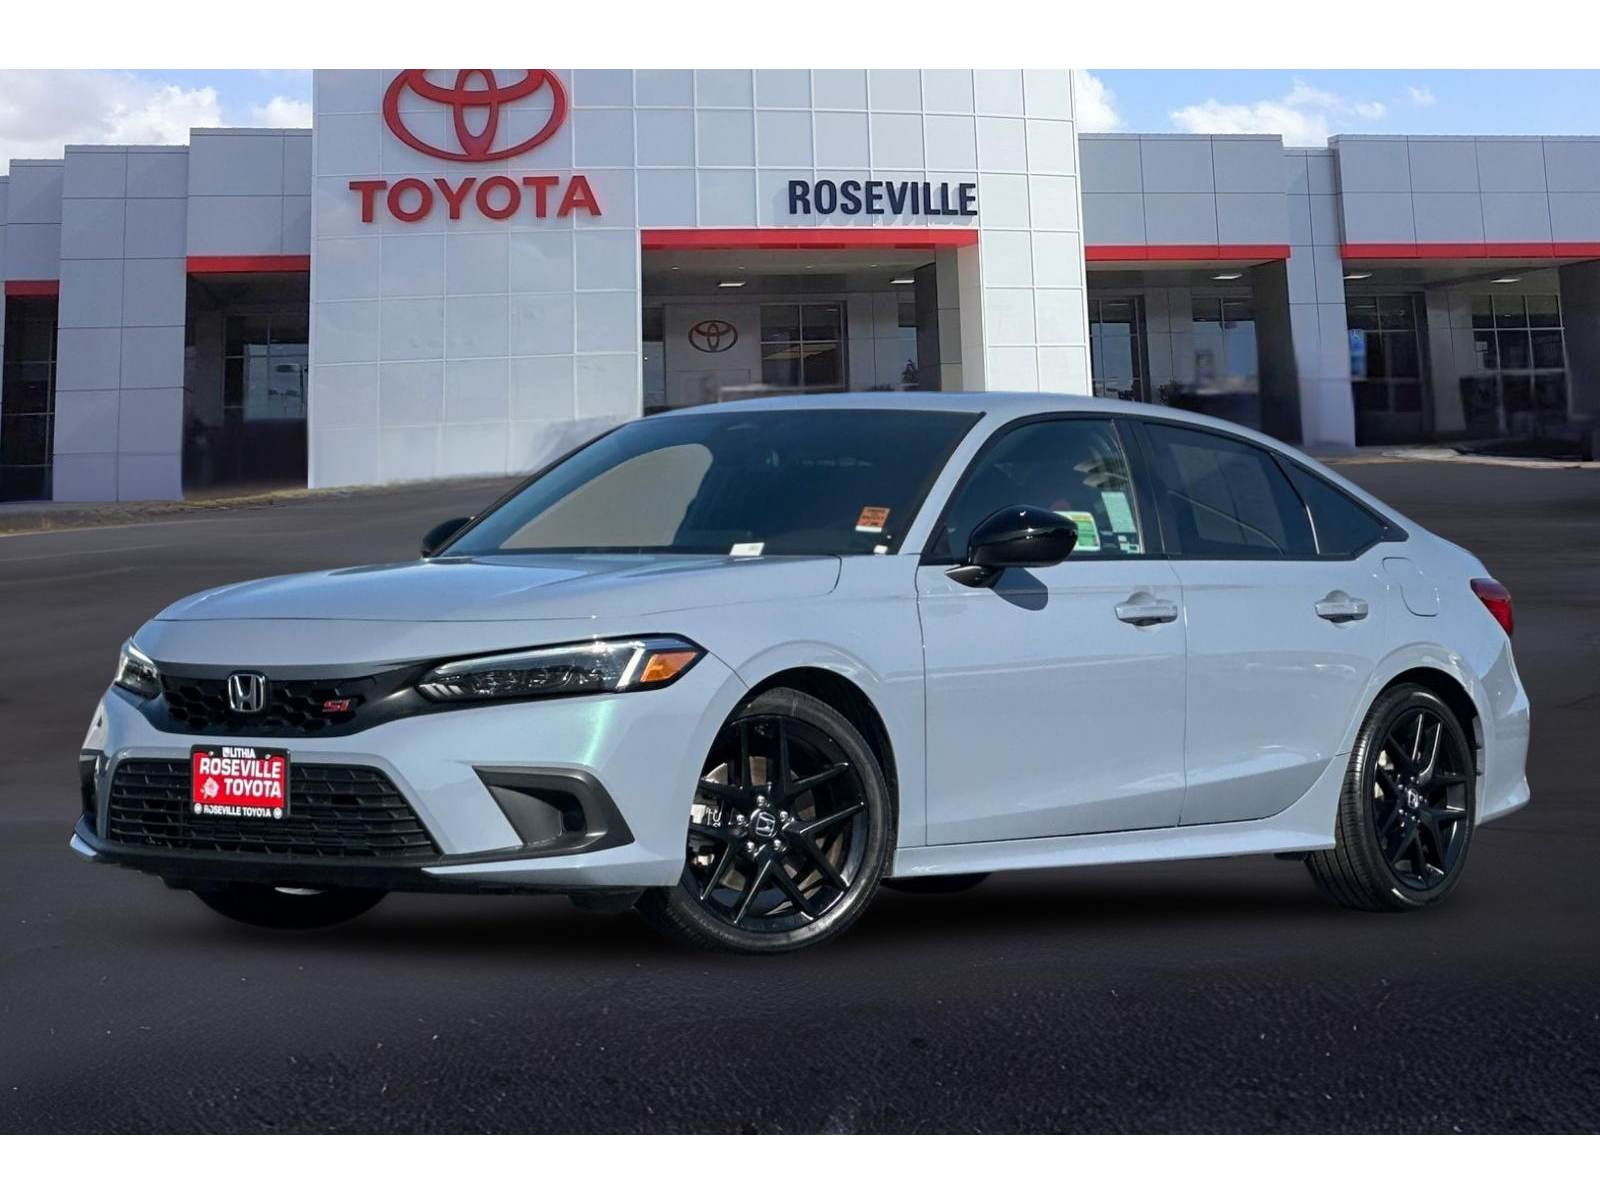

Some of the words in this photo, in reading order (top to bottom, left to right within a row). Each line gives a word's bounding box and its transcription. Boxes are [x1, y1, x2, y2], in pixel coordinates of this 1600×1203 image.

[349, 175, 602, 223] TOYOTA
[788, 179, 978, 216] ROSEVILLE
[230, 747, 256, 759] LITHIA
[200, 758, 282, 779] ROSEVILLE
[224, 778, 282, 798] TOYOTA
[203, 804, 241, 816] ROSEVILLE
[242, 807, 272, 818] TOYOTA
